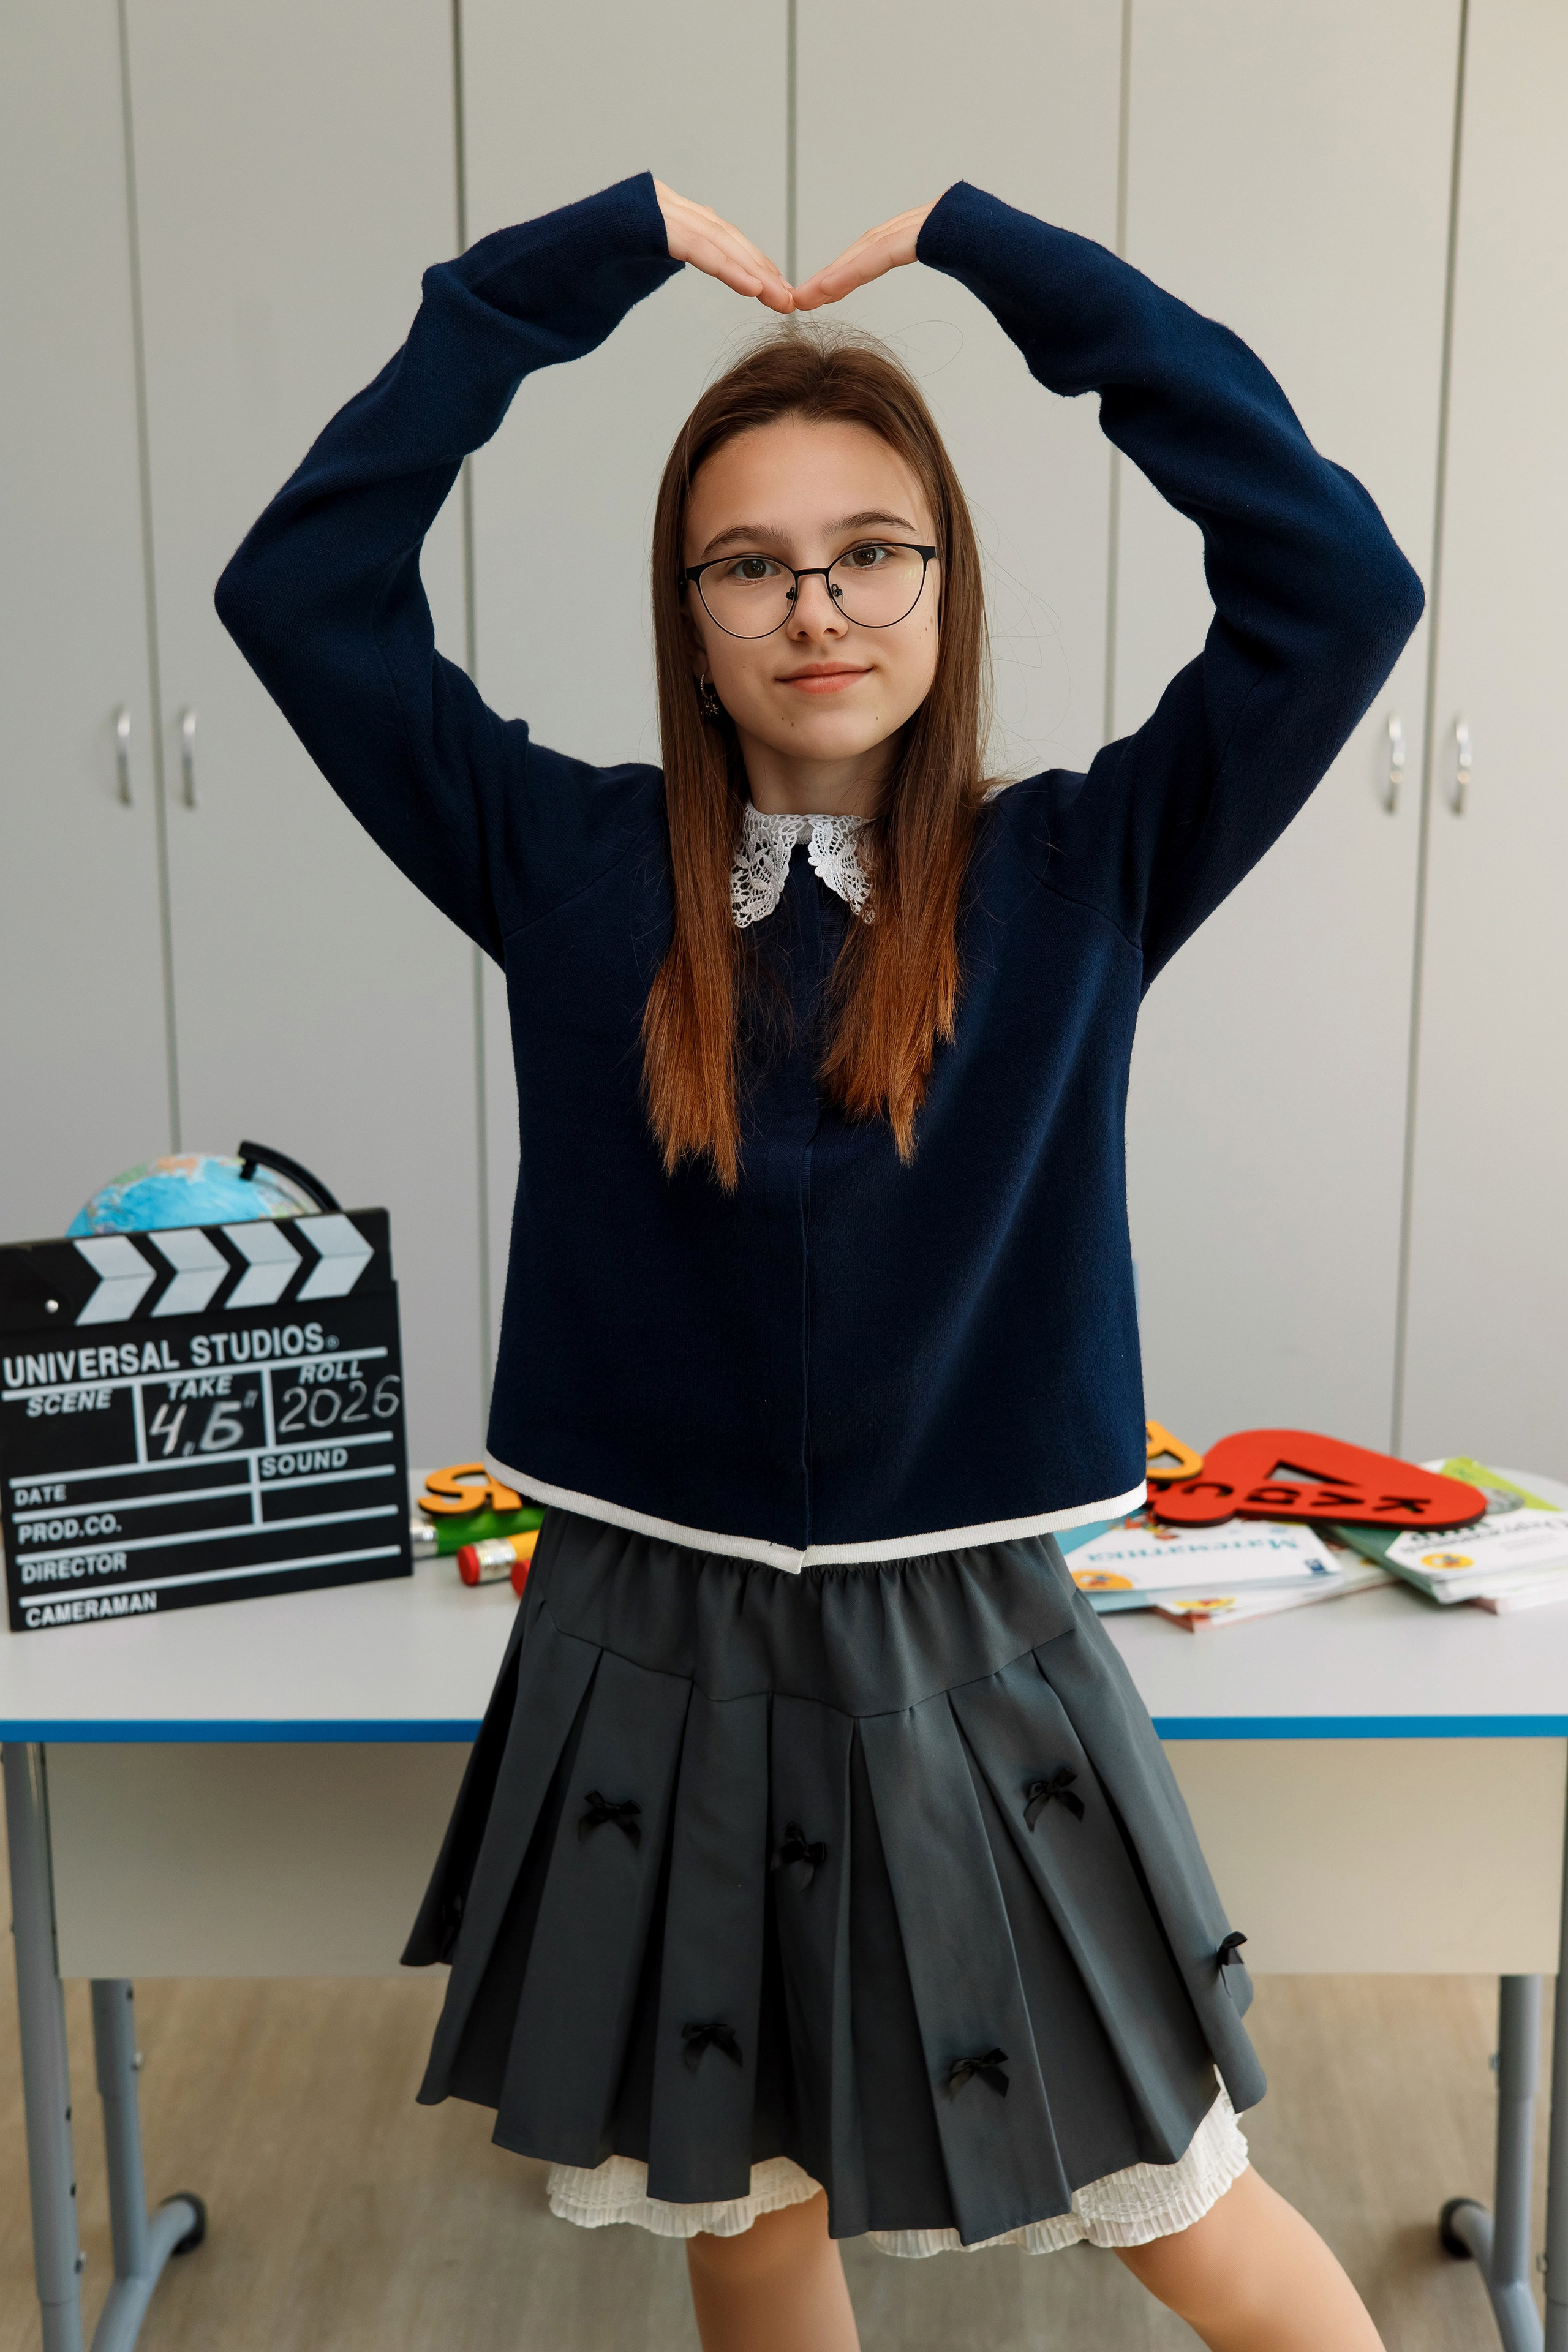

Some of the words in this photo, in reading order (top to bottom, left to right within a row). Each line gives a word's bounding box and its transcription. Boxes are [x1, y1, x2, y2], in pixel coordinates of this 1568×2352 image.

[2, 1339, 180, 1388] UNIVERSAL
[298, 1359, 364, 1385] ROLL
[26, 1387, 113, 1417] SCENE
[167, 1374, 233, 1401] TAKE
[277, 1374, 401, 1433] 2026
[260, 1448, 349, 1477] SOUND
[14, 1484, 67, 1507] DATE
[18, 1513, 123, 1545] PROD.CO.
[21, 1551, 127, 1585] DIRECTOR
[25, 1591, 157, 1628] CAMERAMAN
